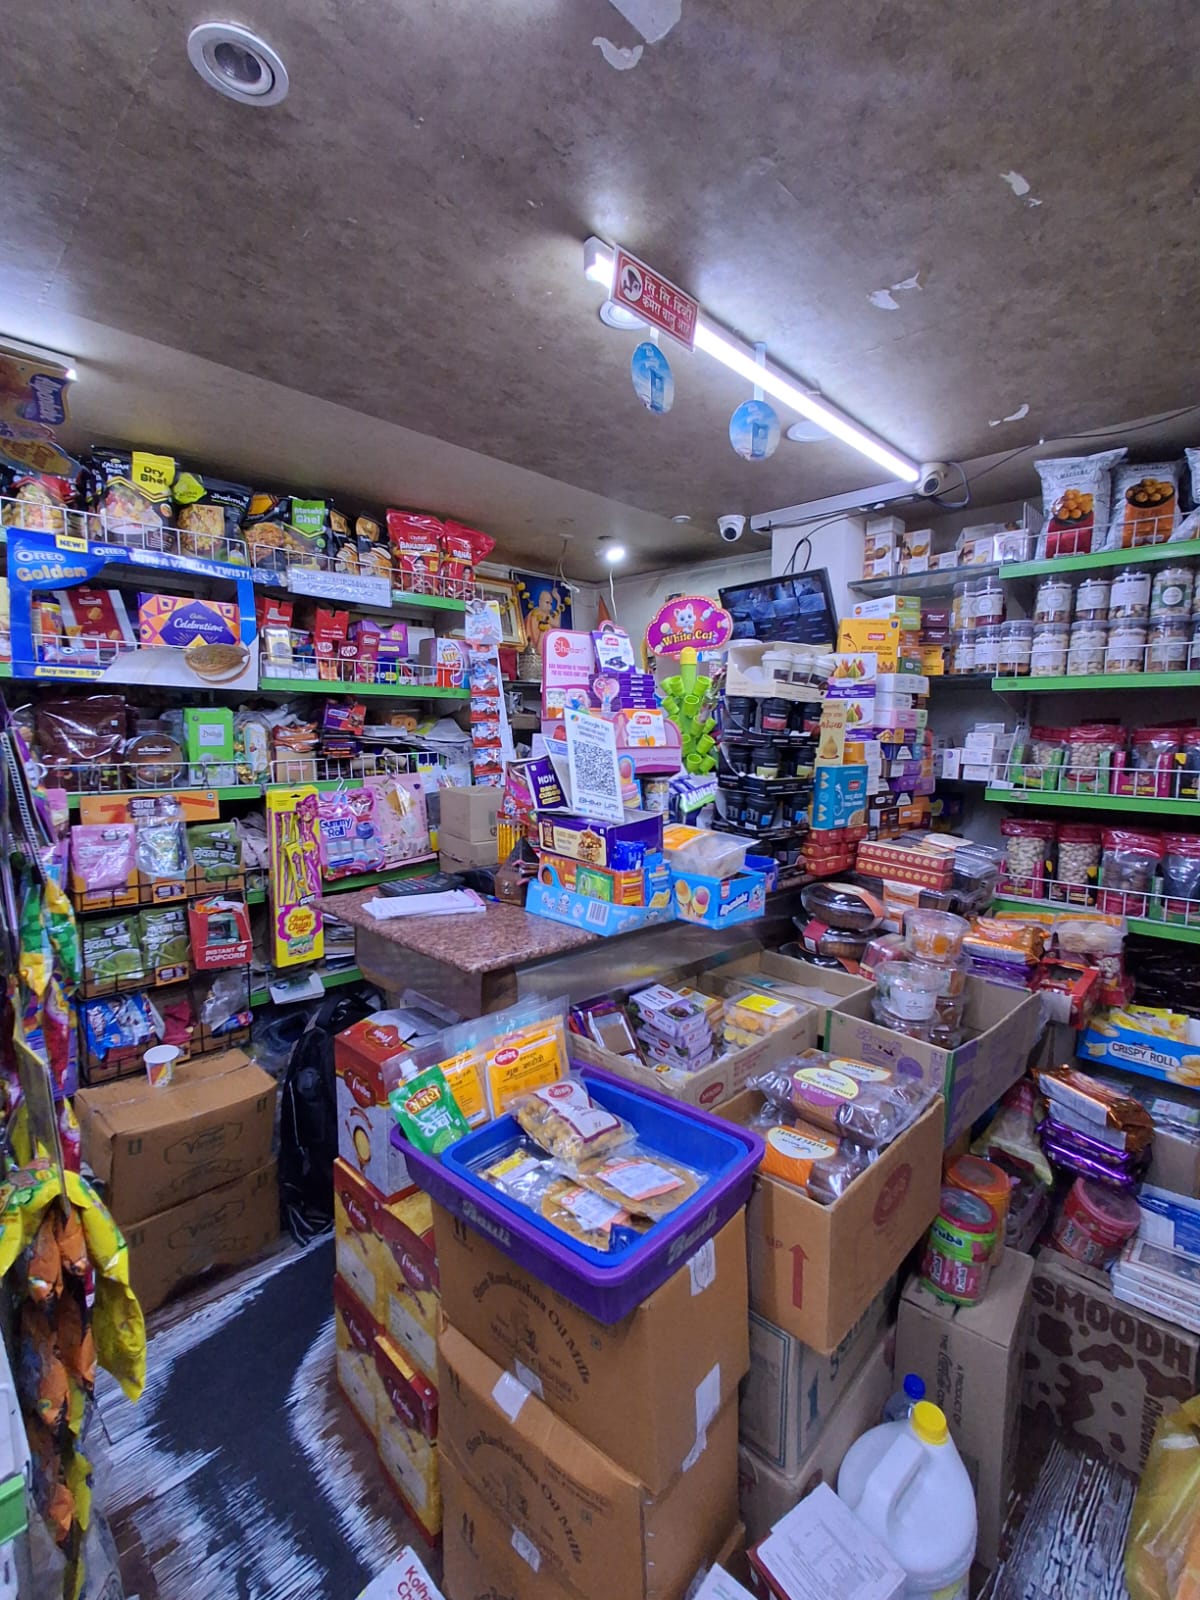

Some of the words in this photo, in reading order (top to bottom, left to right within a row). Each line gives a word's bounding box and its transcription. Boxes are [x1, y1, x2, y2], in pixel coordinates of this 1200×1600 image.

[143, 466, 165, 477] Dry
[140, 473, 167, 486] Bhel
[59, 538, 84, 549] NEW!
[16, 550, 65, 563] OREO
[93, 546, 127, 557] OREO
[16, 564, 88, 582] Golden
[173, 617, 224, 633] Celebrations
[662, 633, 692, 647] White
[694, 629, 714, 640] Cat
[319, 819, 352, 830] Gummy
[327, 829, 345, 840] Roll
[205, 953, 246, 963] POPCORN
[1111, 1042, 1147, 1059] CRISPY
[1149, 1052, 1176, 1068] ROLL
[1031, 1276, 1192, 1377] SMOODH
